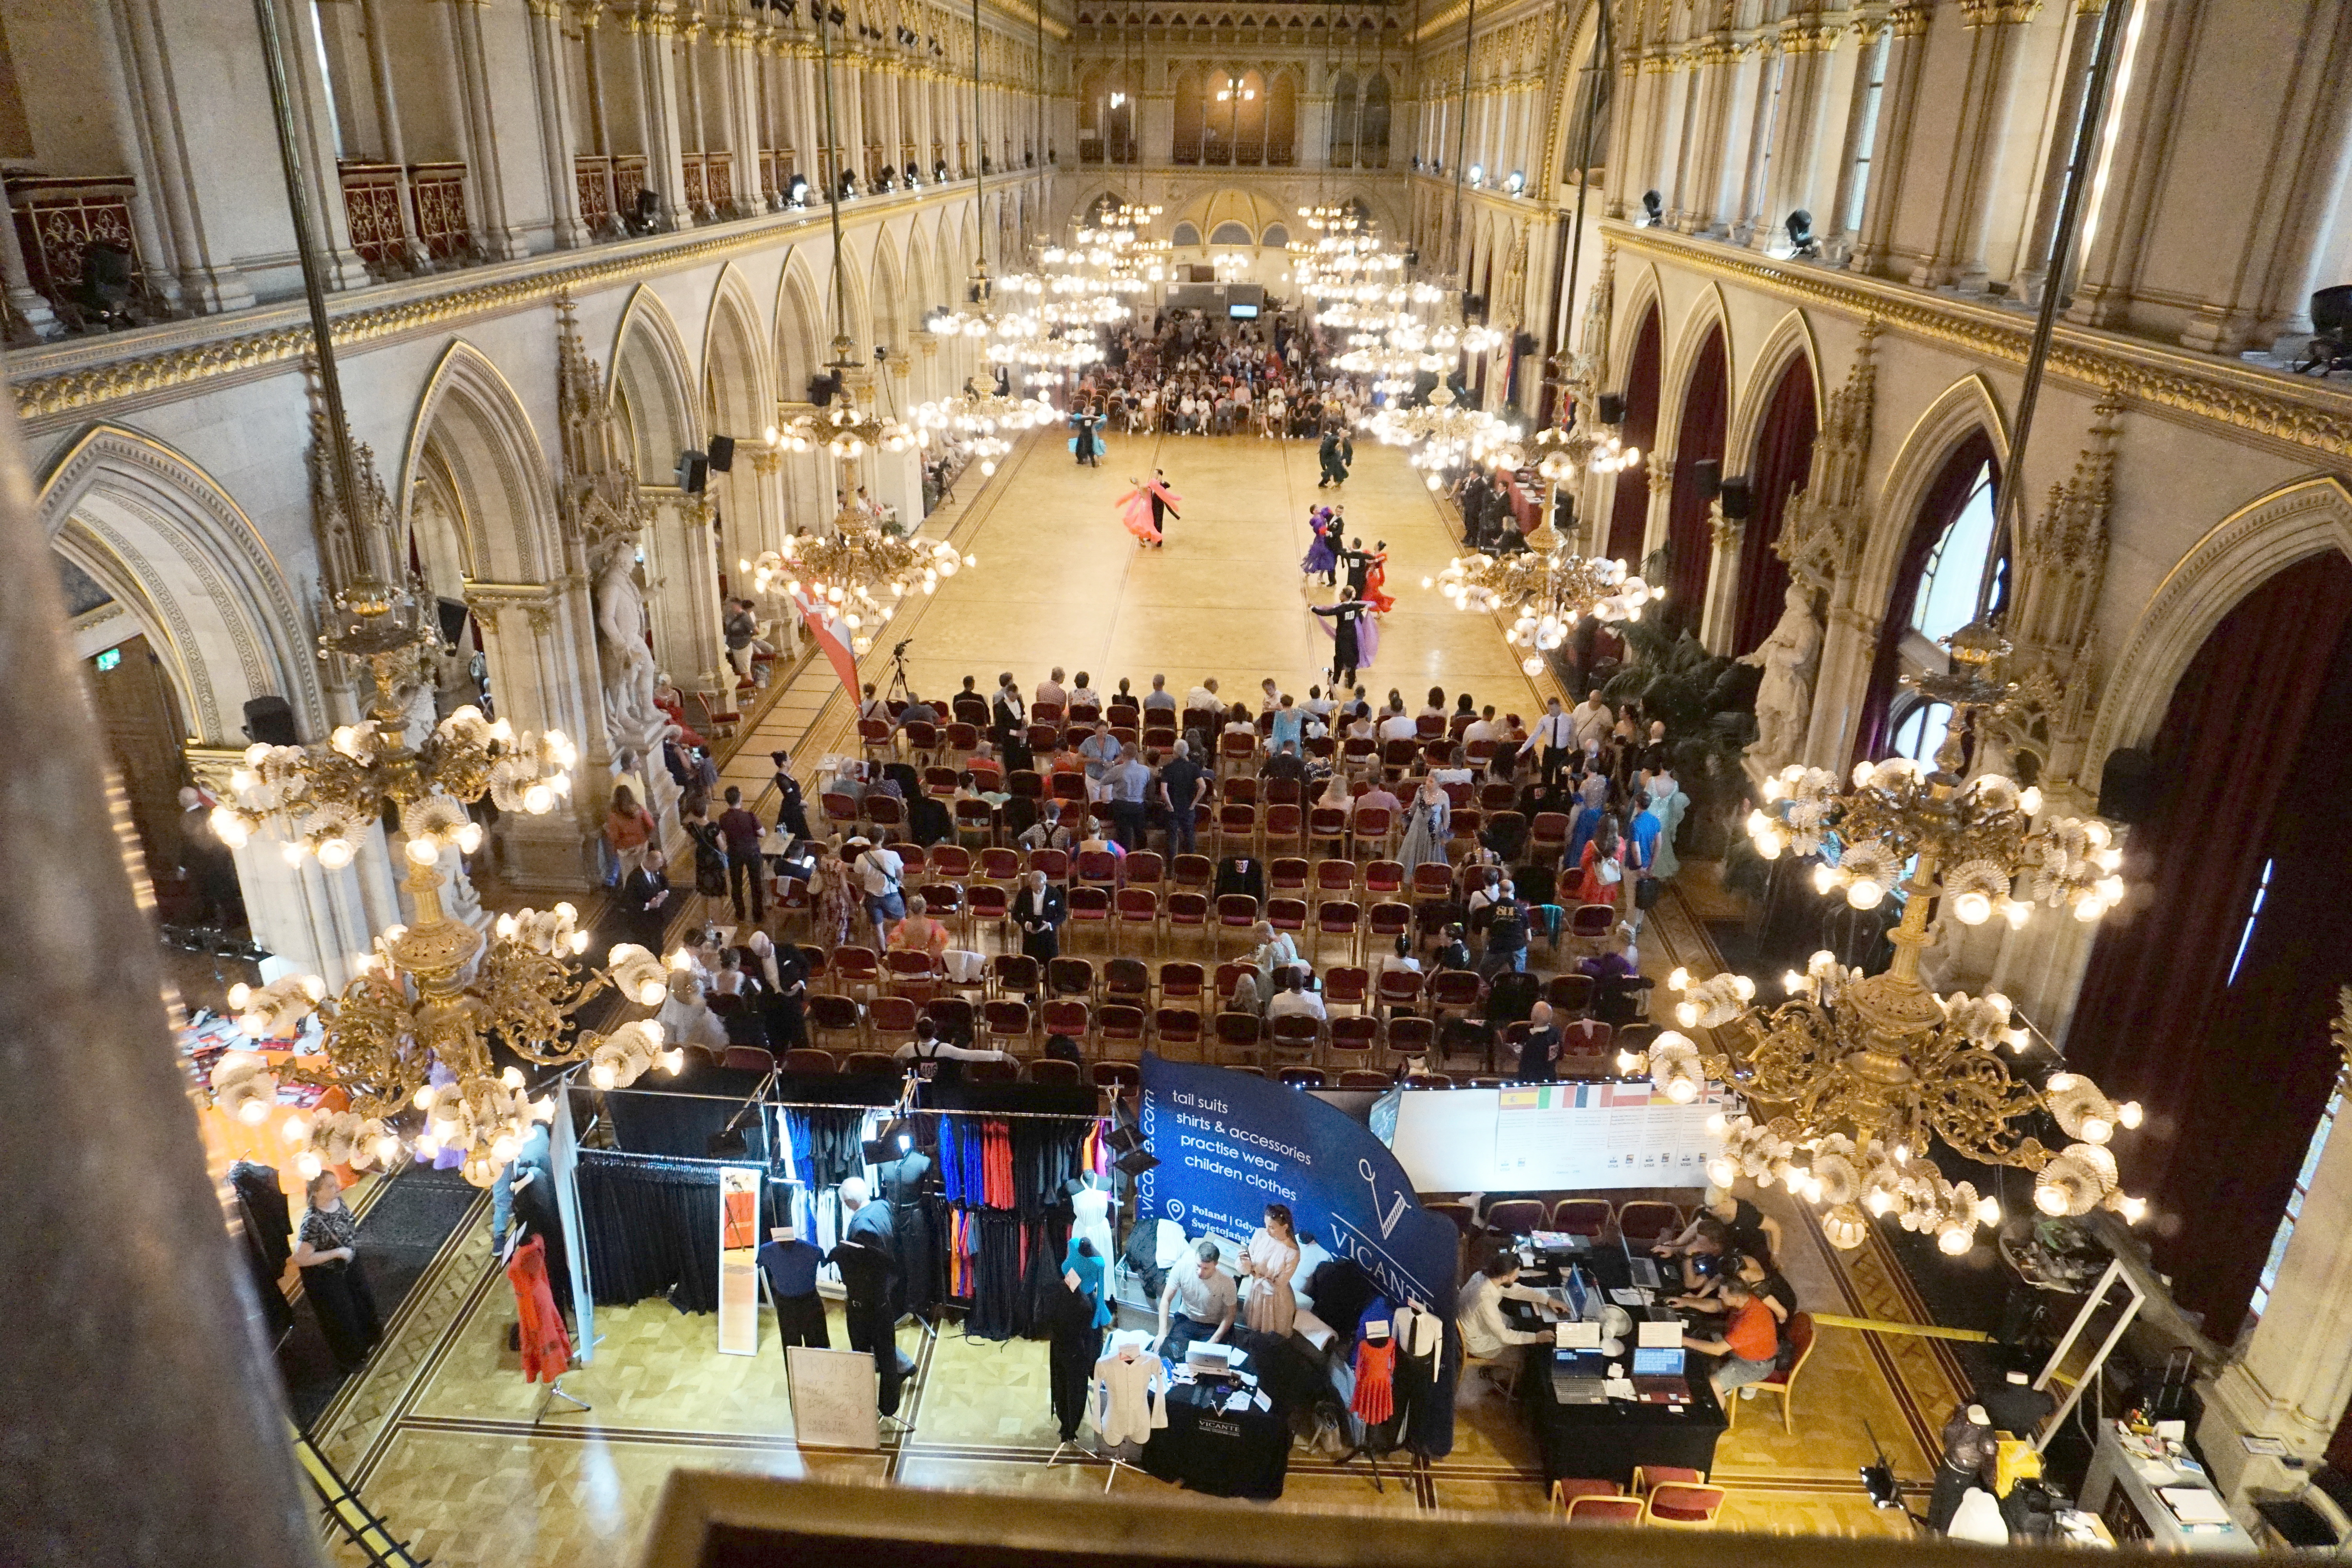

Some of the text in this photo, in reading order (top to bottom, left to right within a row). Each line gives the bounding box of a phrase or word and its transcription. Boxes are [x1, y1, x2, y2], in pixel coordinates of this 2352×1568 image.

[921, 1065, 937, 1076] 406
[1173, 1090, 1228, 1114] tail suits
[1177, 1112, 1310, 1165] shirts & accessories
[1181, 1135, 1279, 1172] practise wear
[1185, 1155, 1296, 1201] children clothes
[1192, 1205, 1227, 1222] Poland
[797, 1355, 863, 1379] PROMO
[1199, 1420, 1240, 1432] VICANTE
